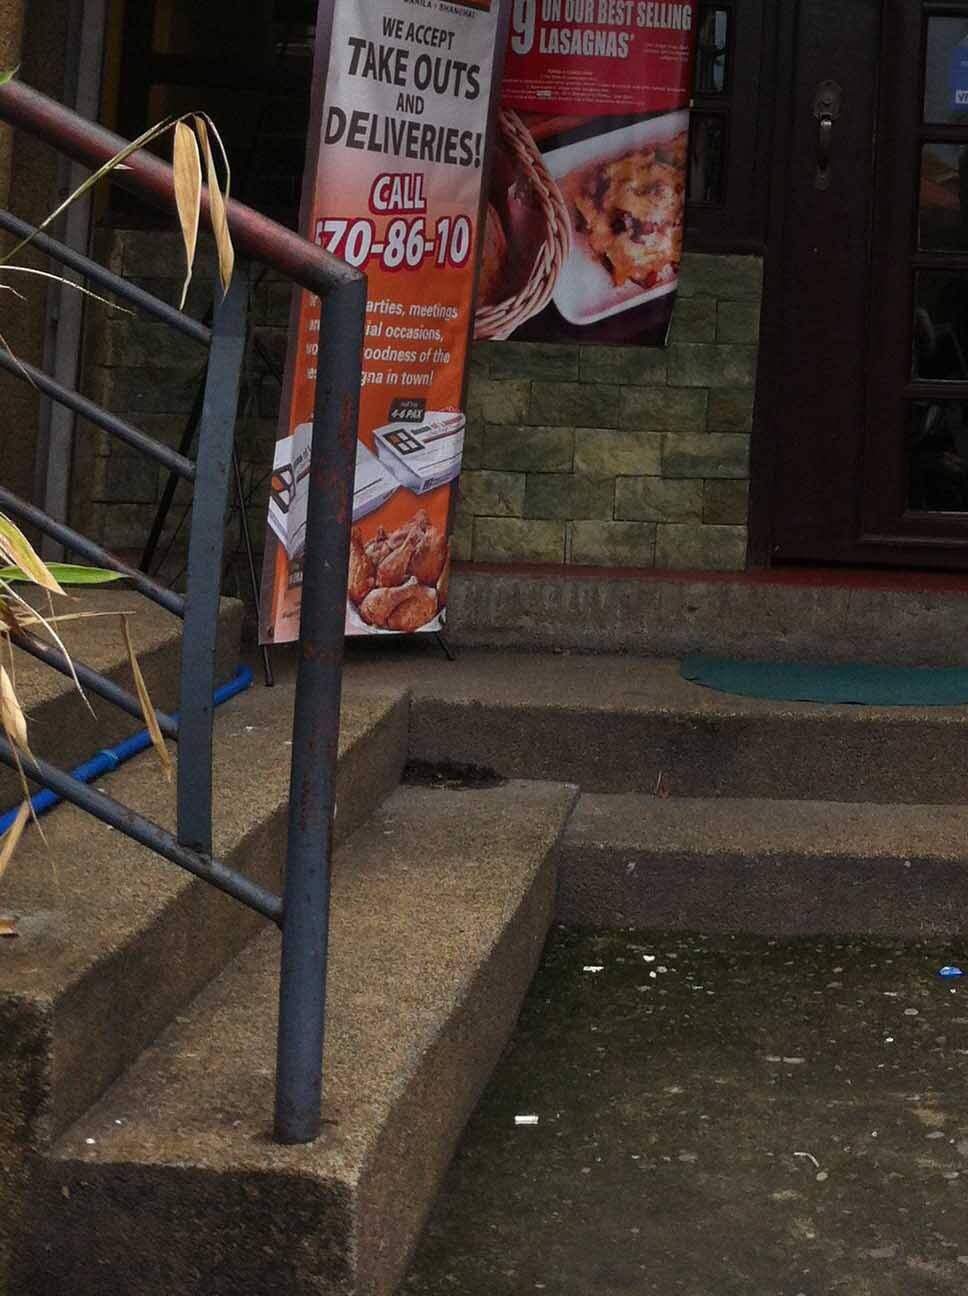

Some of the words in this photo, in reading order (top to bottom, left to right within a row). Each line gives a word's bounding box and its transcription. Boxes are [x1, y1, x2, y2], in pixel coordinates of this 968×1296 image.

[597, 0, 633, 27] BEST
[635, 3, 693, 32] SELLING
[382, 16, 405, 39] WE
[407, 21, 456, 51] ACCEPT
[347, 36, 410, 88] TAKE
[413, 53, 481, 100] OUTS
[395, 92, 425, 116] AND
[323, 105, 483, 169] DELIVERIES!
[371, 173, 427, 212] CALL
[366, 298, 406, 317] arties,
[408, 303, 460, 321] meetings
[363, 345, 417, 363] oodness
[386, 368, 399, 385] in
